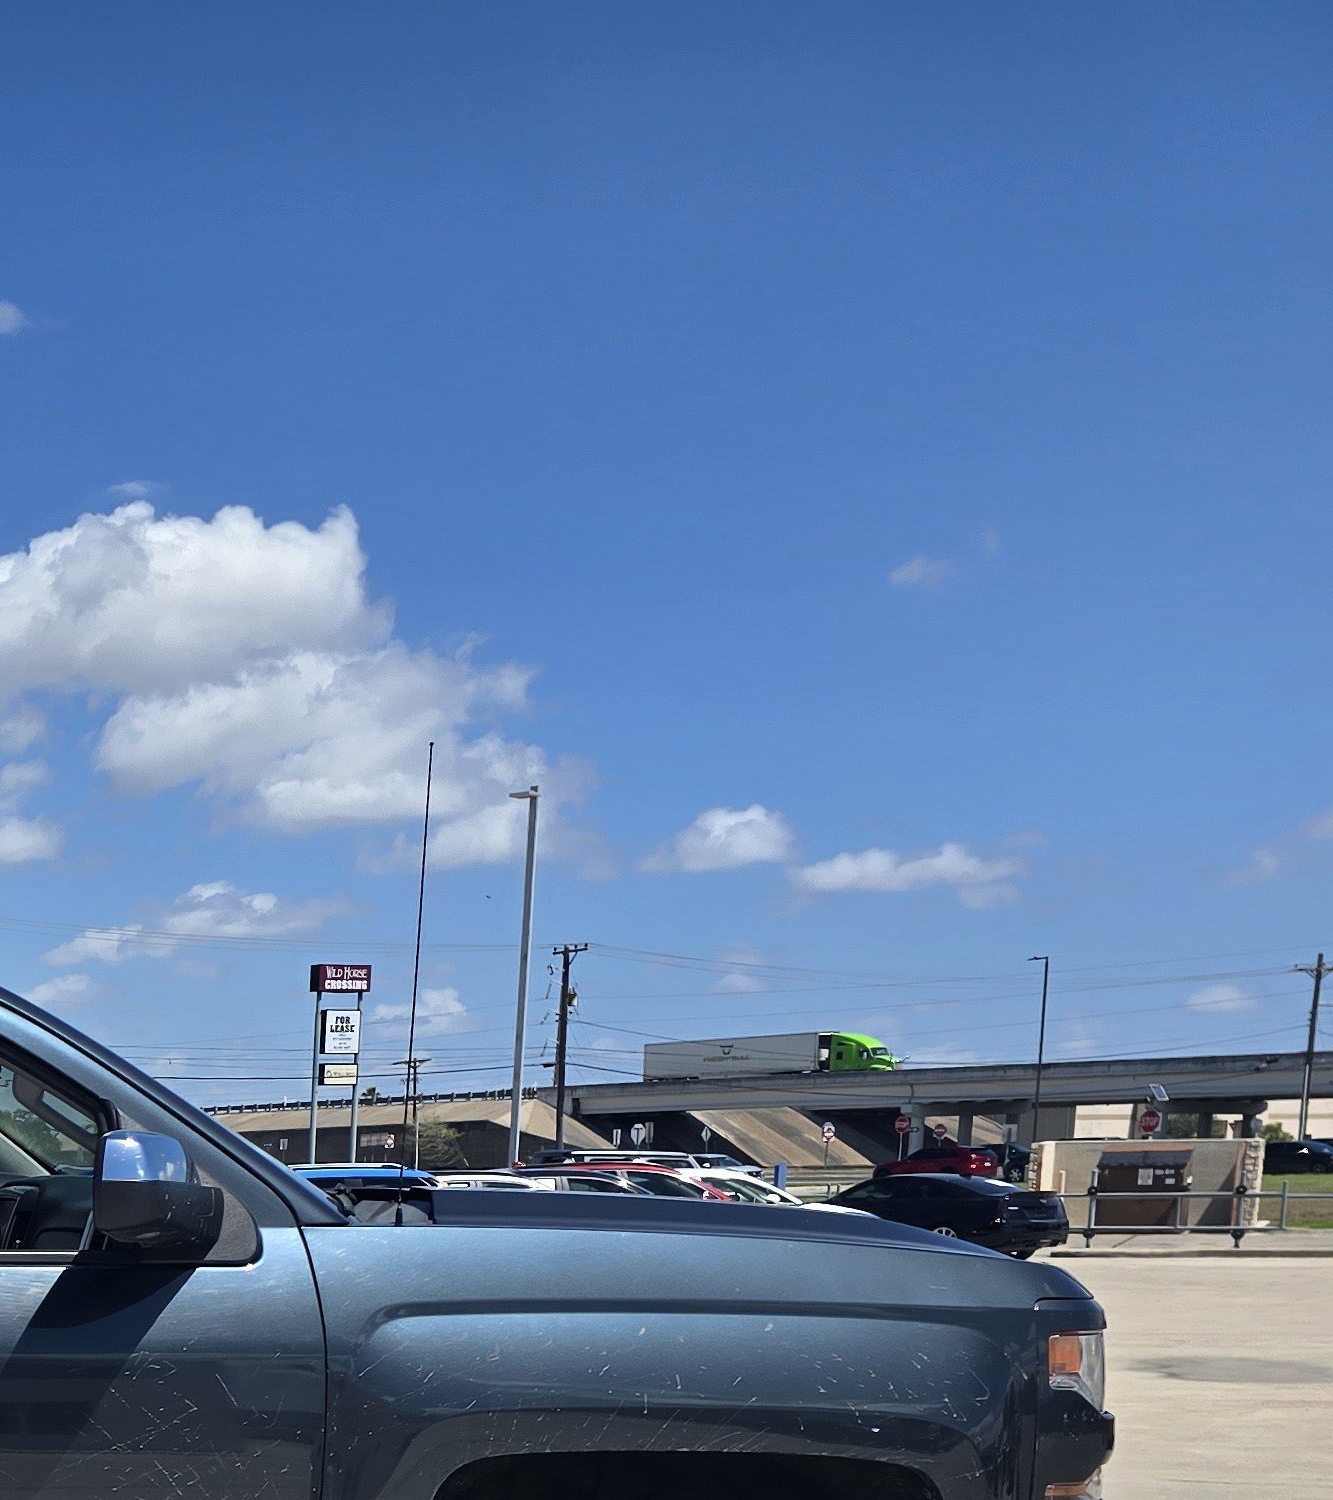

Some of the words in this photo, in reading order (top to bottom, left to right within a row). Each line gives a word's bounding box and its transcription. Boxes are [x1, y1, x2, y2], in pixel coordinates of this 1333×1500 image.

[344, 967, 367, 979] HORSE
[325, 980, 367, 990] CROSSING
[335, 1016, 351, 1025] FOR
[330, 1025, 355, 1033] LEASE
